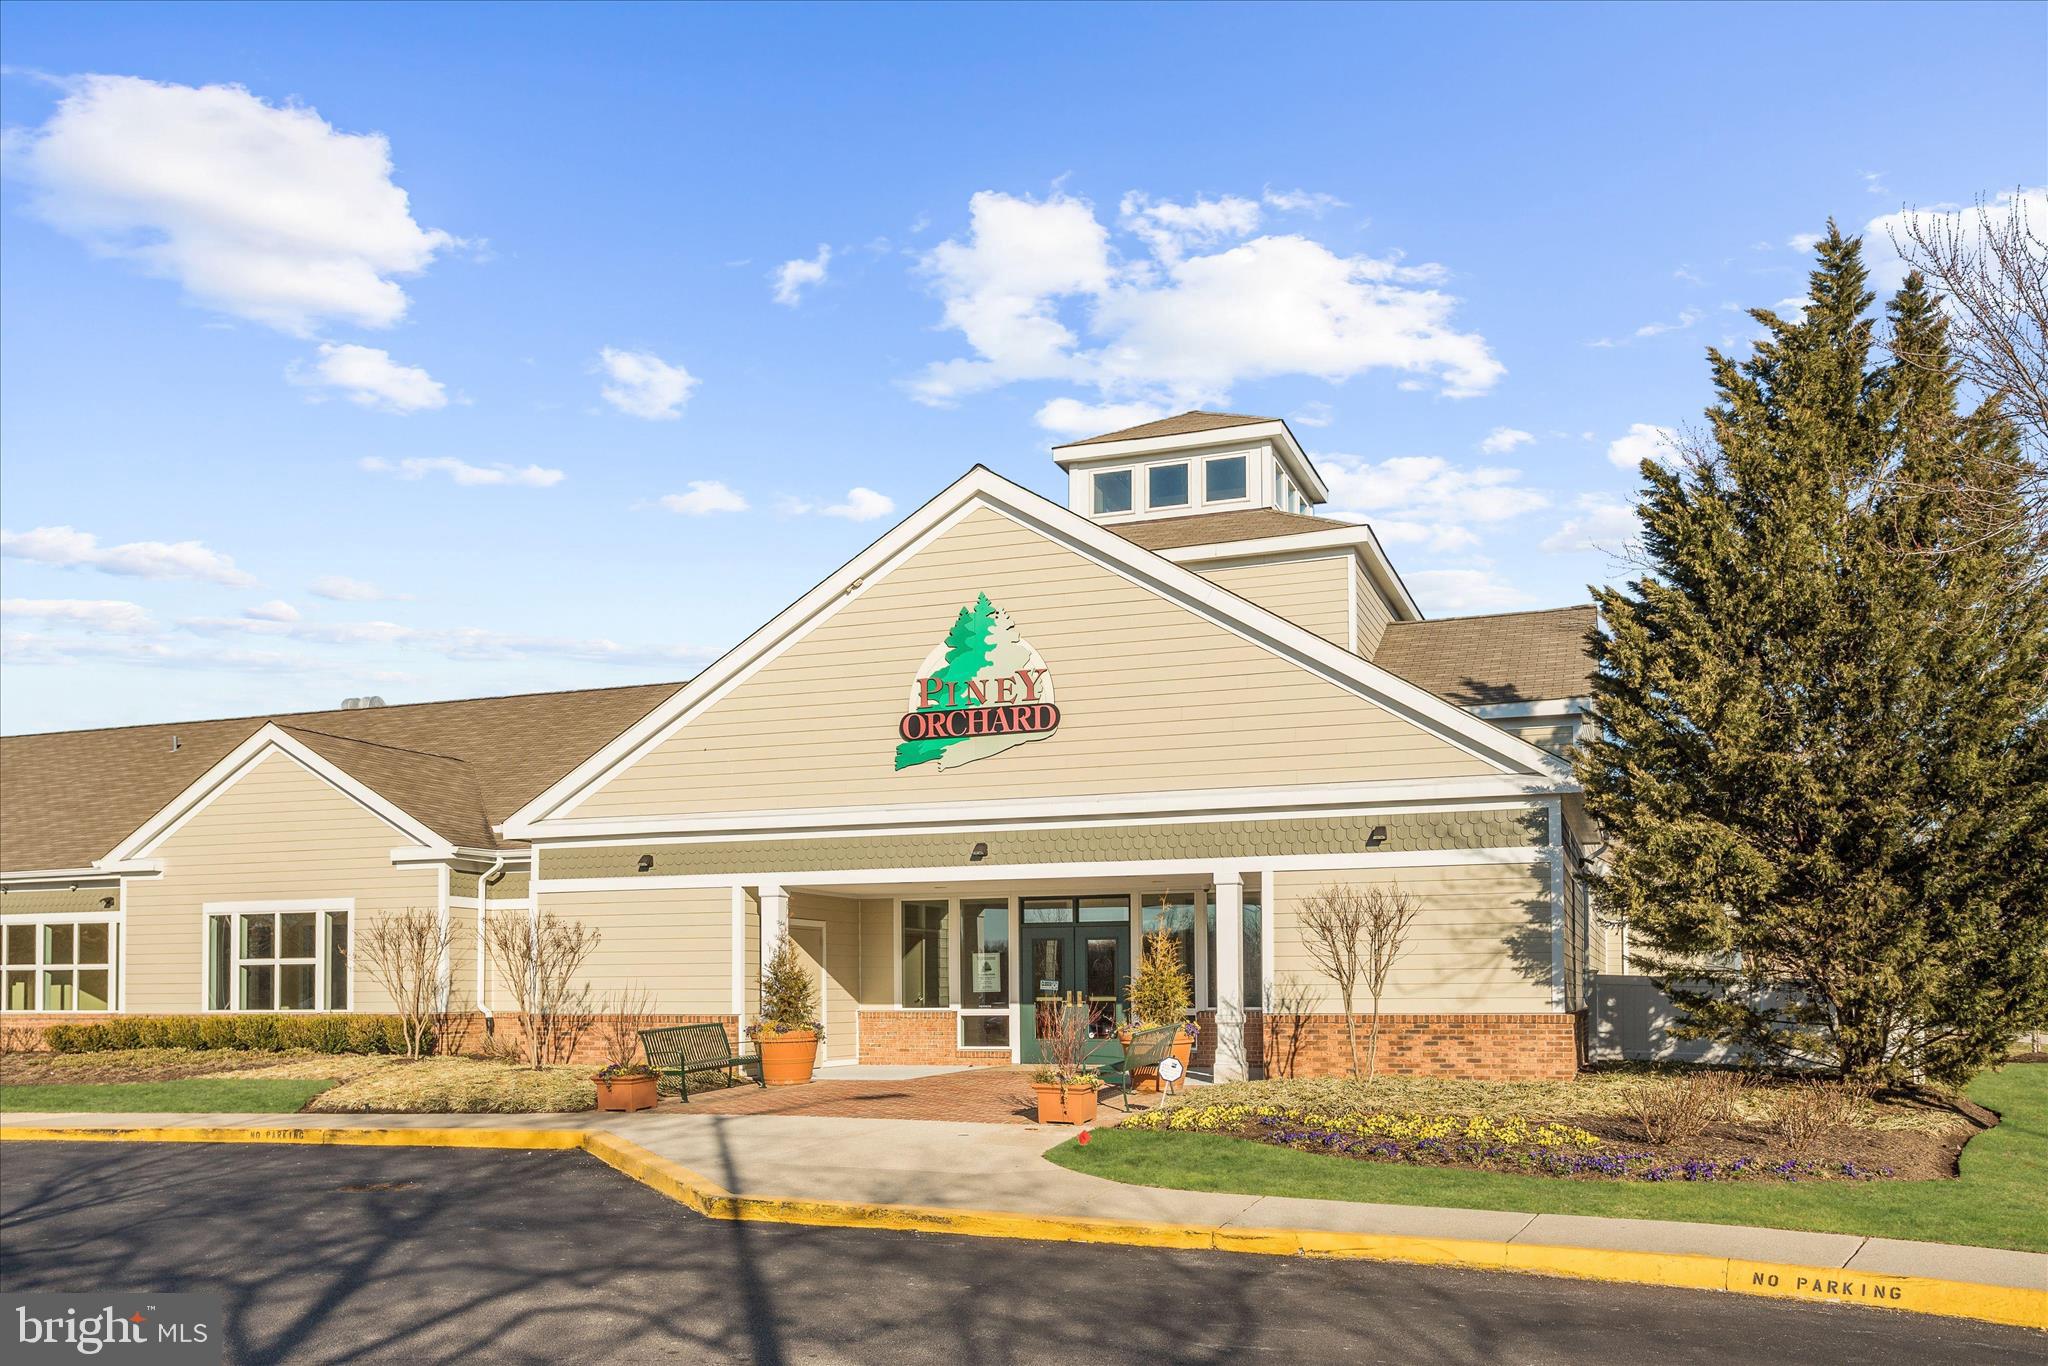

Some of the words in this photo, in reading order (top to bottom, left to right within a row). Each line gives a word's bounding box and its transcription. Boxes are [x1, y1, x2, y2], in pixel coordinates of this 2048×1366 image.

[916, 668, 1047, 710] PINEY
[902, 704, 1057, 740] ORCHARD
[250, 1131, 261, 1140] NO
[266, 1130, 304, 1140] PARKING
[1752, 1272, 1779, 1287] NO
[1796, 1276, 1902, 1300] PARKING
